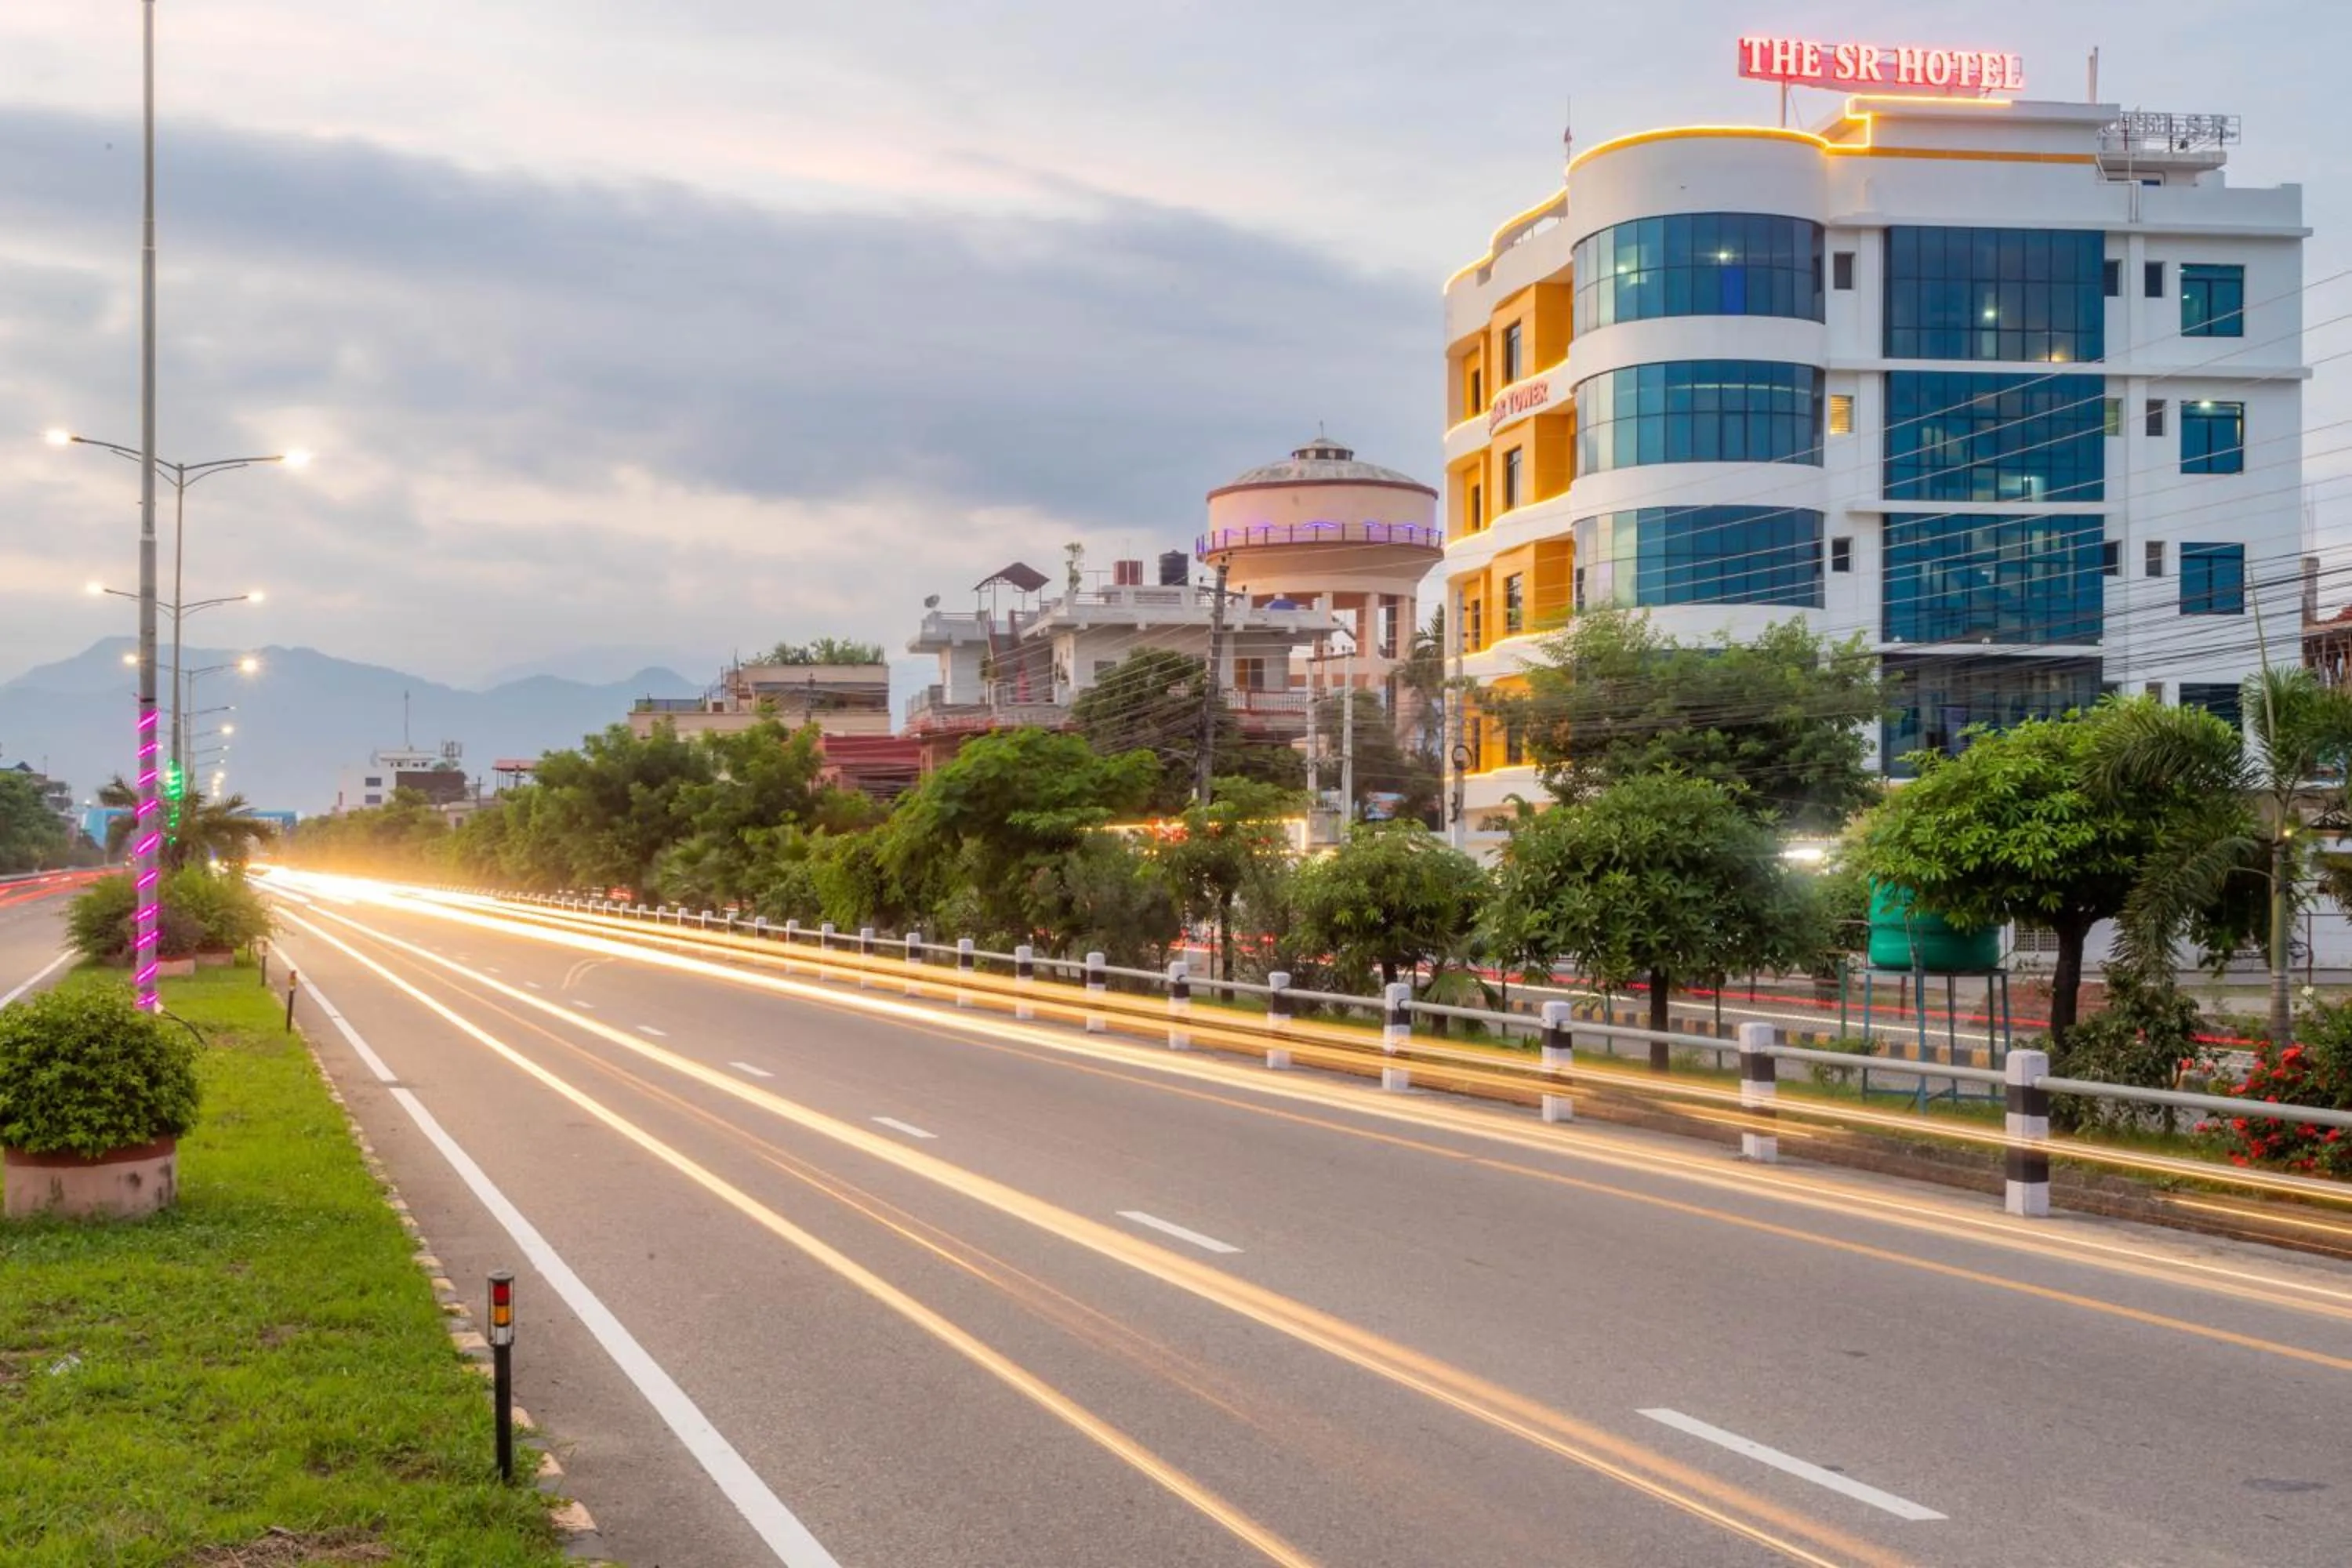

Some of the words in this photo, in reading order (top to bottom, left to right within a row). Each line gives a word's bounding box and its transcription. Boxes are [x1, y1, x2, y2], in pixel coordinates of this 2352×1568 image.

[1741, 37, 1823, 77] THE
[1834, 44, 1882, 82] SR
[1895, 47, 2024, 89] HOTEL
[1508, 379, 1549, 415] TOWER
